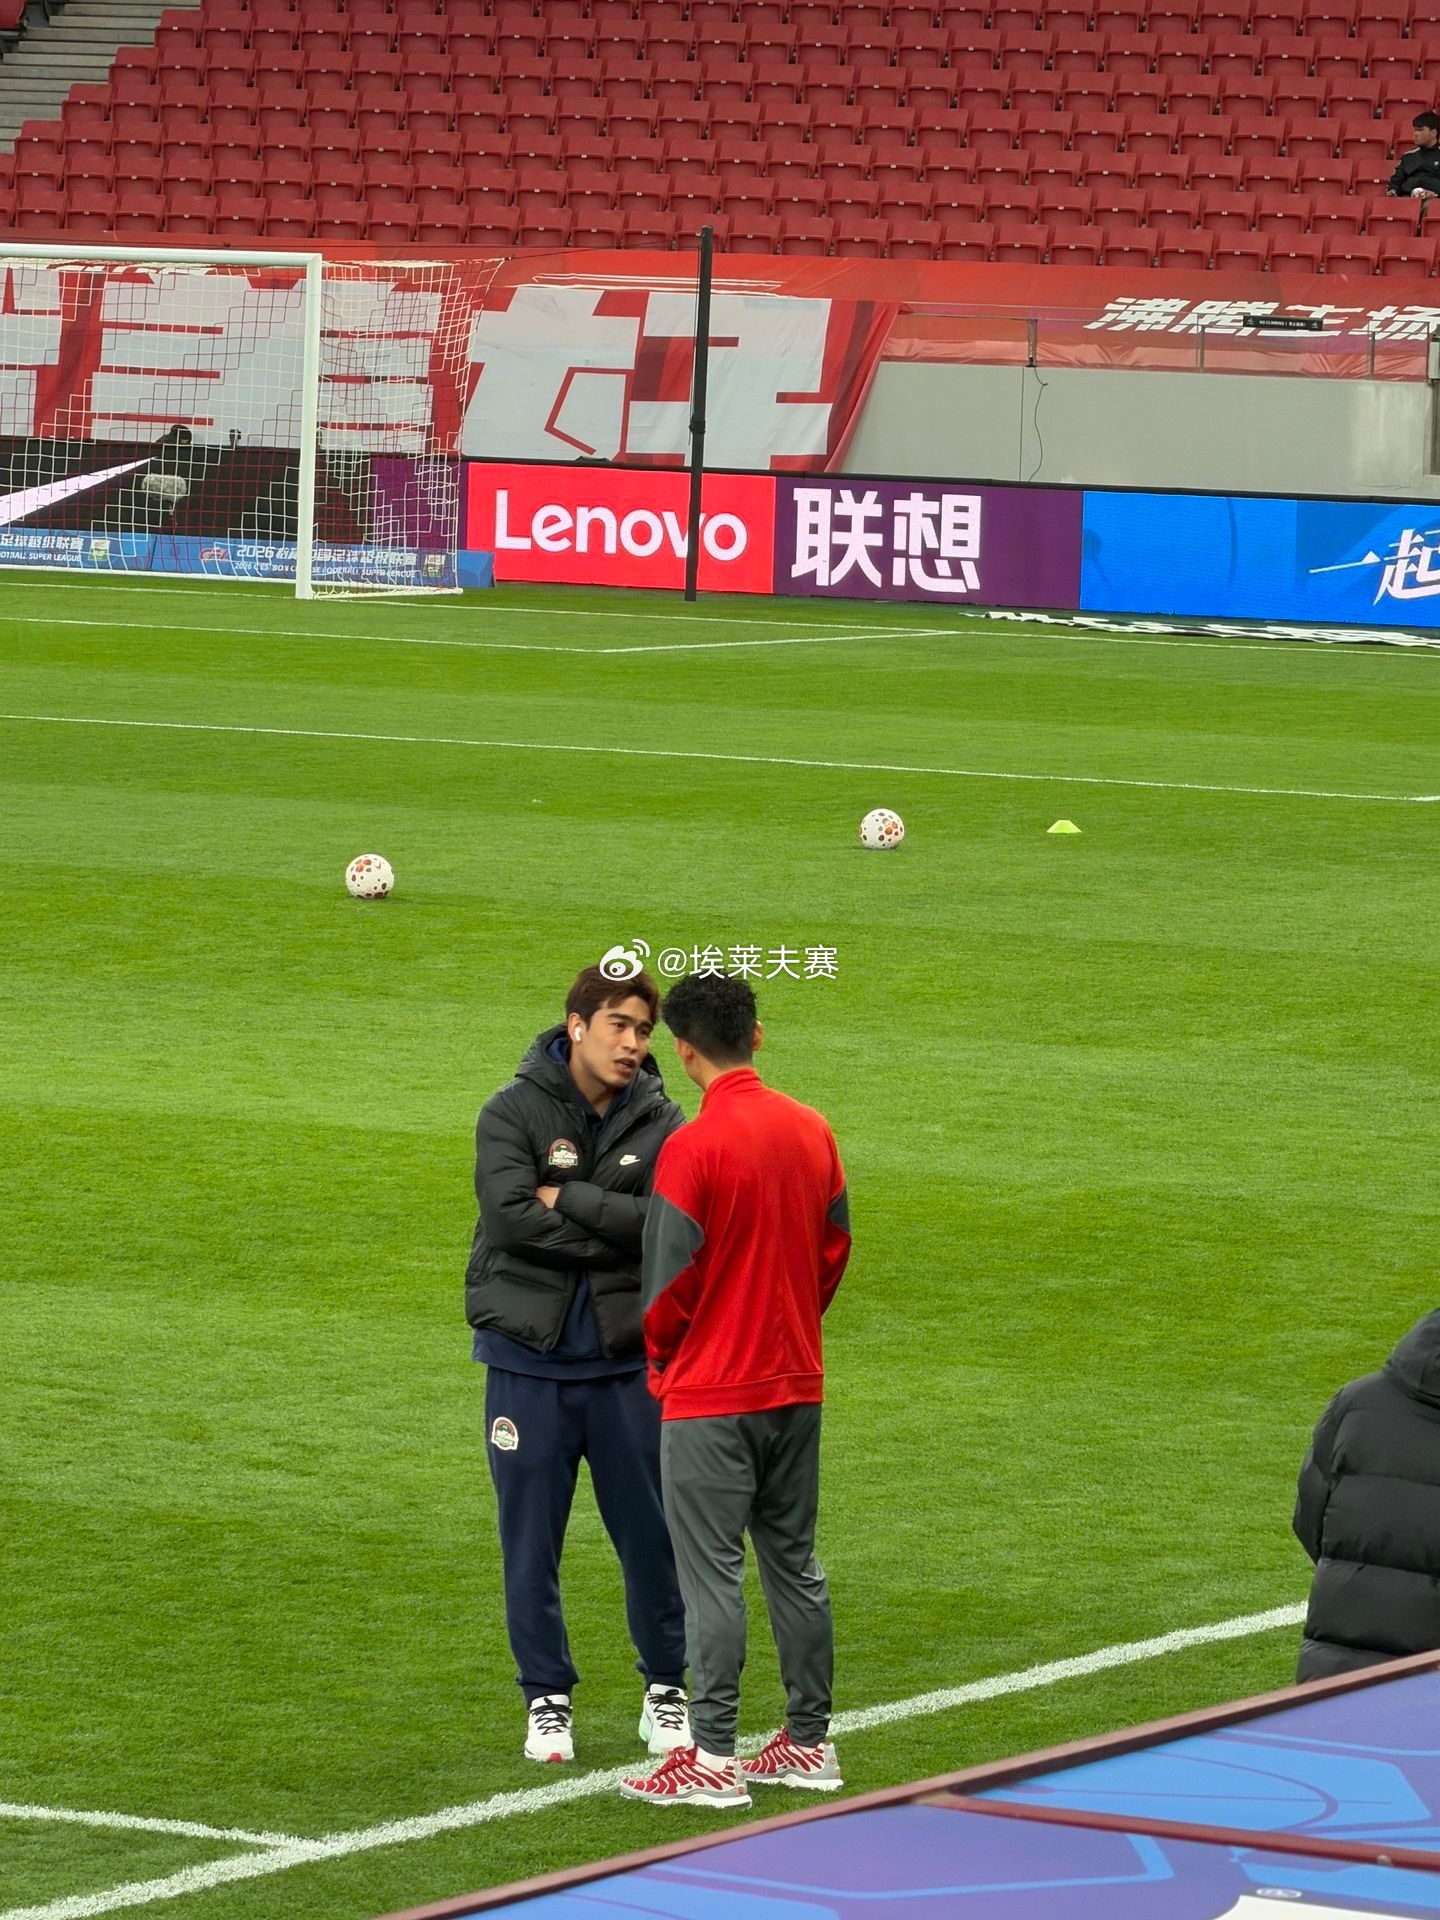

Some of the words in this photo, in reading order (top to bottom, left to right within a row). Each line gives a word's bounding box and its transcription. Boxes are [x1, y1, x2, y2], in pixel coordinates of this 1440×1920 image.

[28, 552, 52, 561] SUPER
[494, 488, 748, 562] Lenovo
[791, 487, 982, 594] 联想
